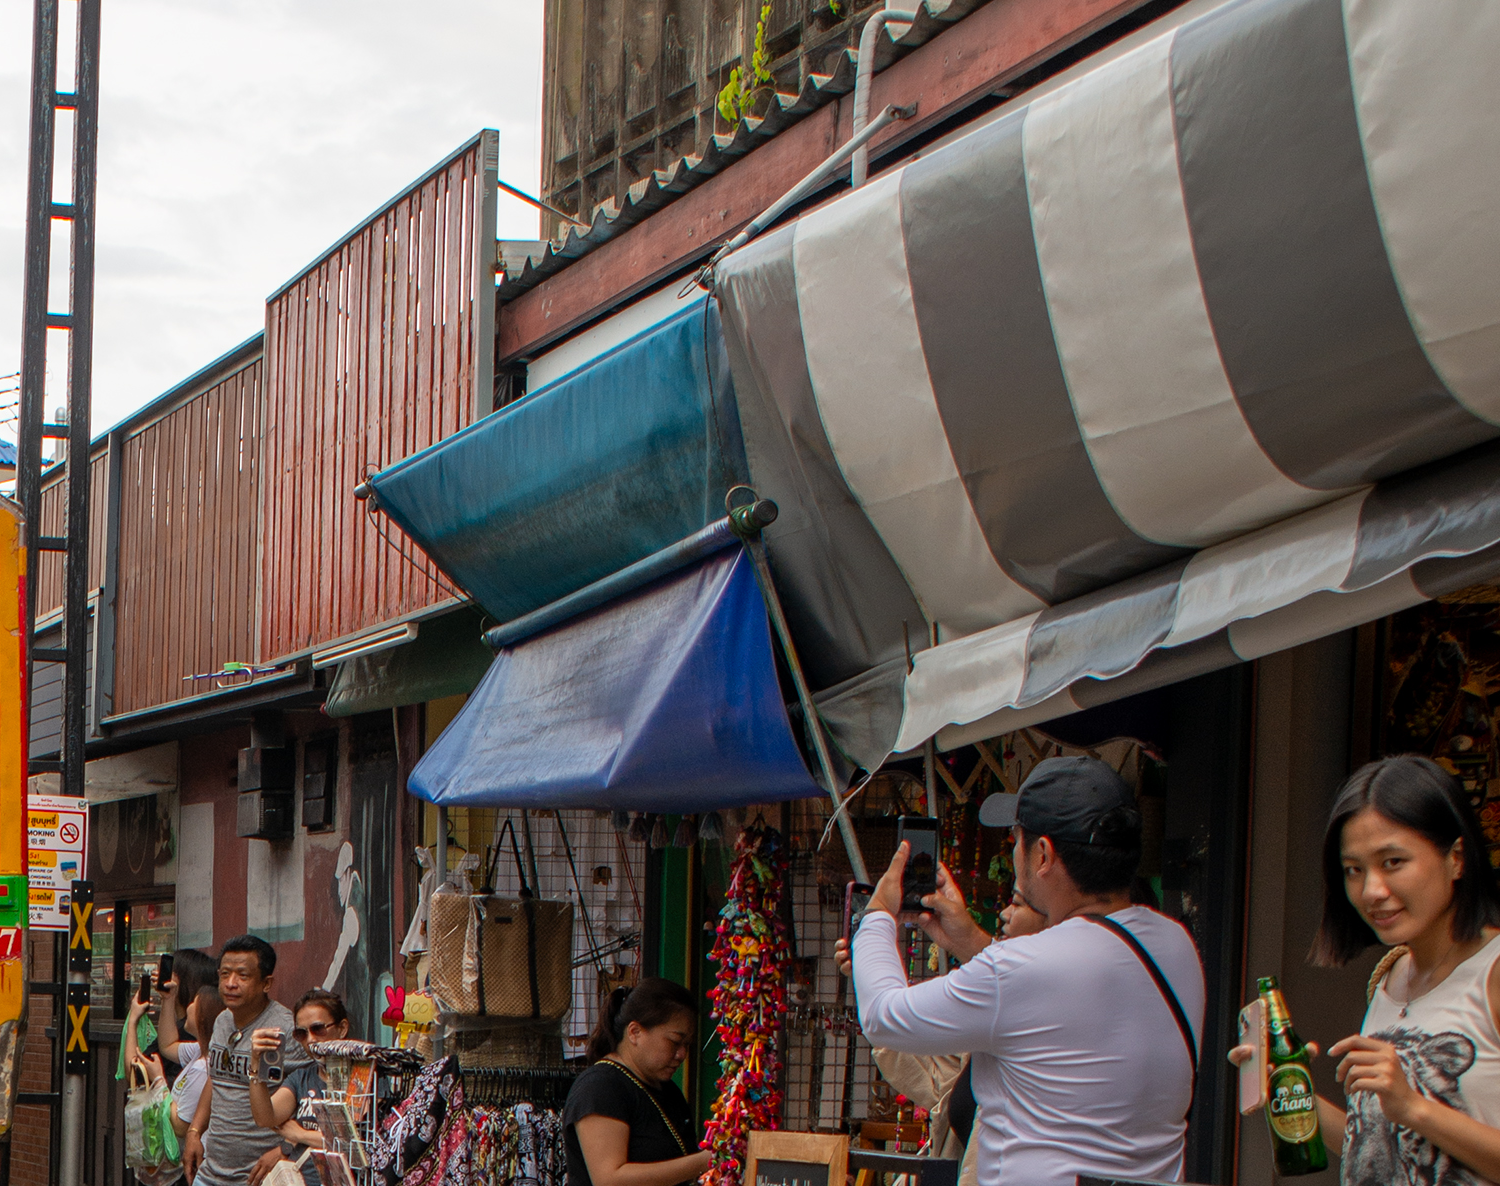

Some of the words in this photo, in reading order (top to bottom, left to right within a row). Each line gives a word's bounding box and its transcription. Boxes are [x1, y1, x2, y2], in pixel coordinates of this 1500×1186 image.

[27, 830, 55, 838] MOKING
[28, 838, 46, 846] 吸烟
[405, 1002, 429, 1015] 100
[1271, 1096, 1313, 1113] Chang
